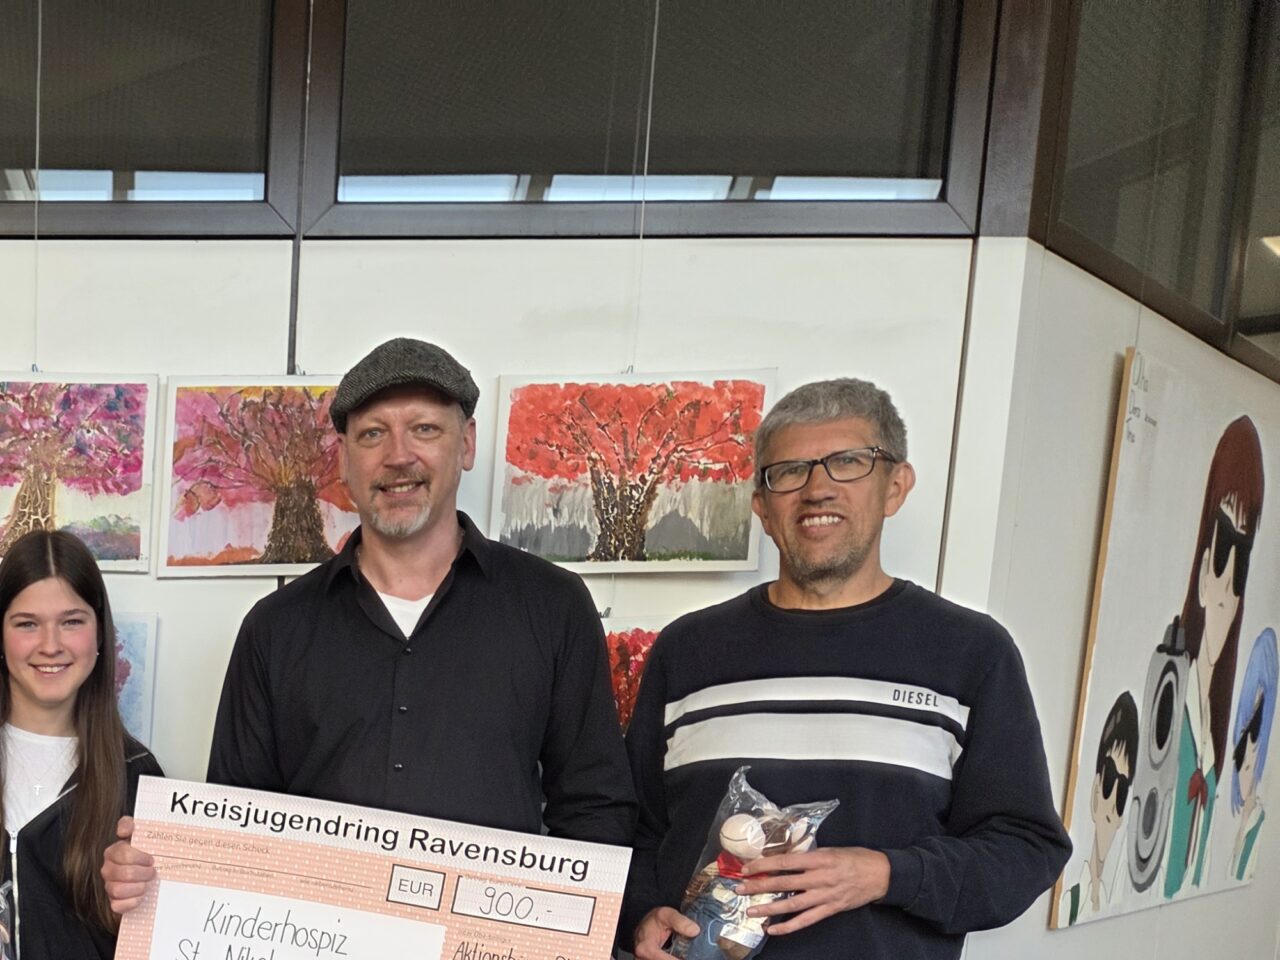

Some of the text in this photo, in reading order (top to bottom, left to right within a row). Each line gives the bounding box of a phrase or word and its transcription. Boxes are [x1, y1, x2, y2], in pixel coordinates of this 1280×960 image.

[892, 688, 940, 708] DIESEL
[170, 791, 590, 882] Kreisjugendring Ravensburg
[397, 878, 435, 897] EUR
[203, 899, 348, 957] Kinderhospiz
